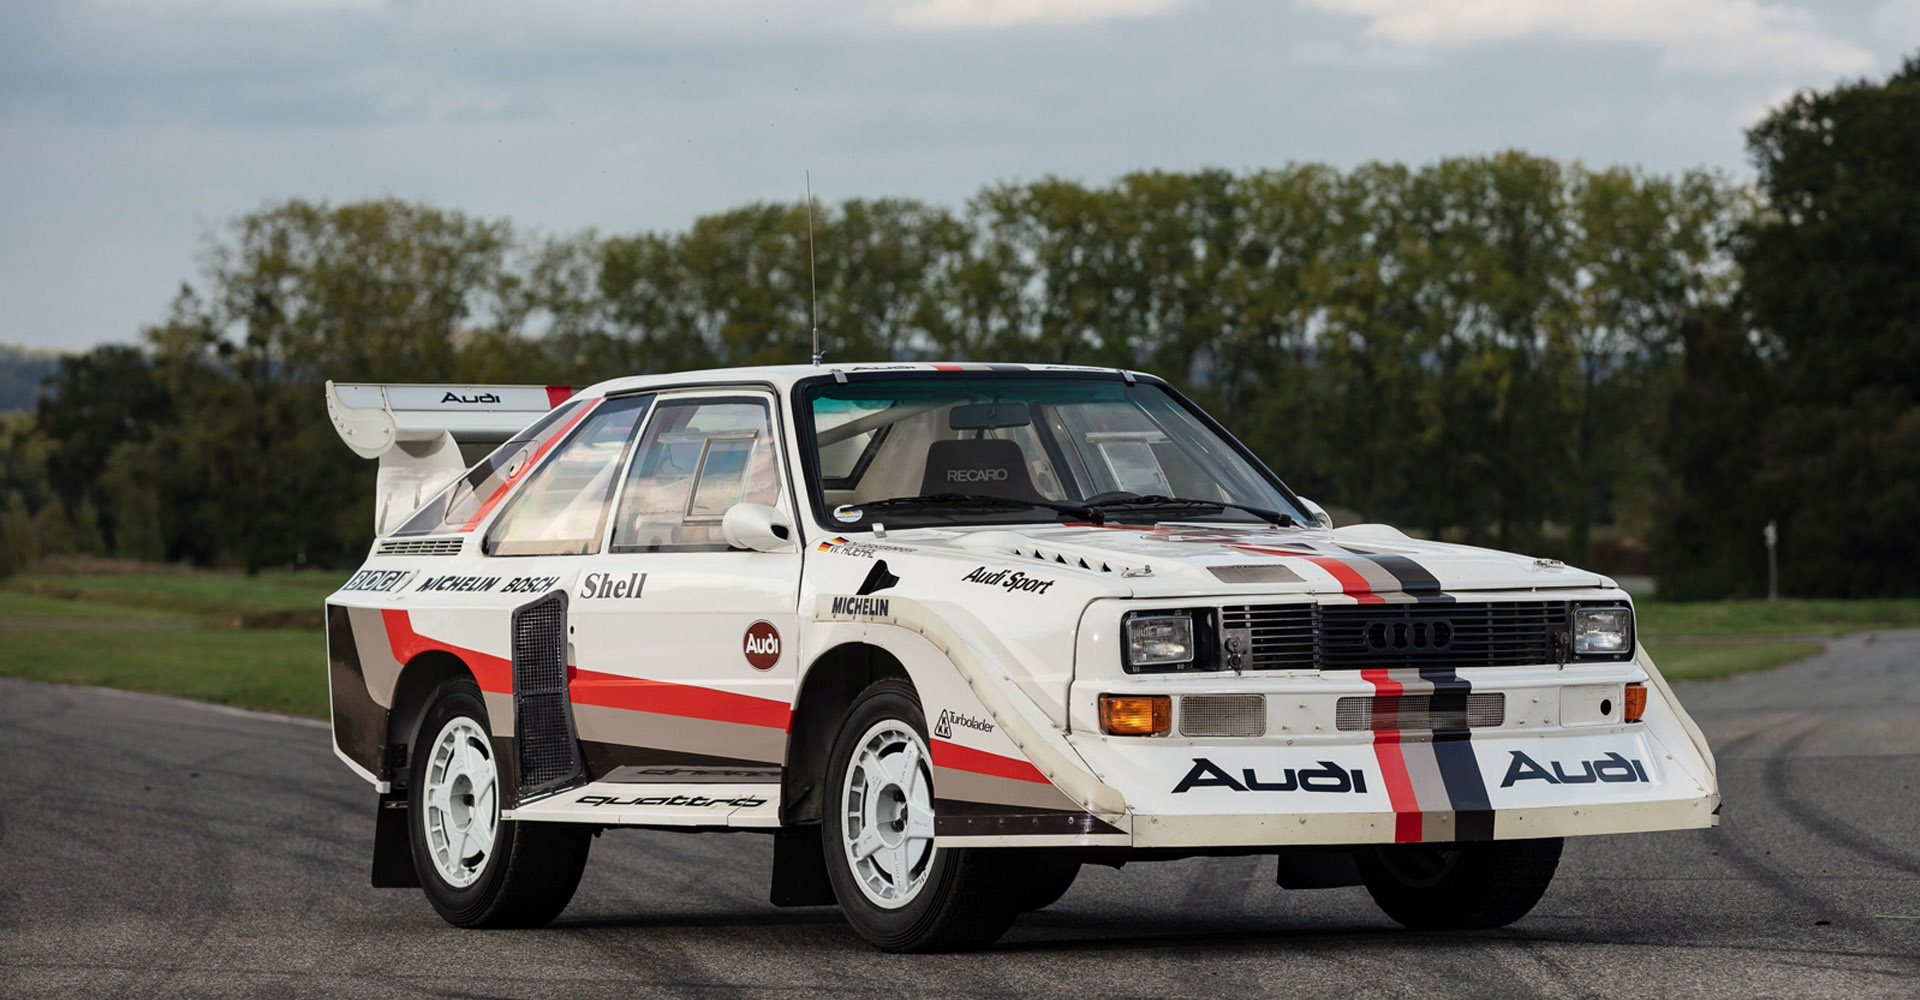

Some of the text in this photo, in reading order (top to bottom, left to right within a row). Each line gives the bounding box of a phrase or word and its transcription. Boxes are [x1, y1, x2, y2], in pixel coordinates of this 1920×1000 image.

[440, 391, 501, 404] Audi
[947, 468, 1008, 482] RECARO
[415, 575, 502, 593] MICHELIN
[500, 576, 560, 593] BOSCH
[580, 573, 648, 599] Shell
[961, 566, 1055, 595] Audi Sport
[831, 596, 889, 617] MICHELIN
[746, 633, 779, 655] Audi
[949, 710, 995, 733] Turbolader
[1170, 757, 1368, 794] Audi
[1499, 750, 1650, 789] Audi
[575, 794, 768, 808] quattro
